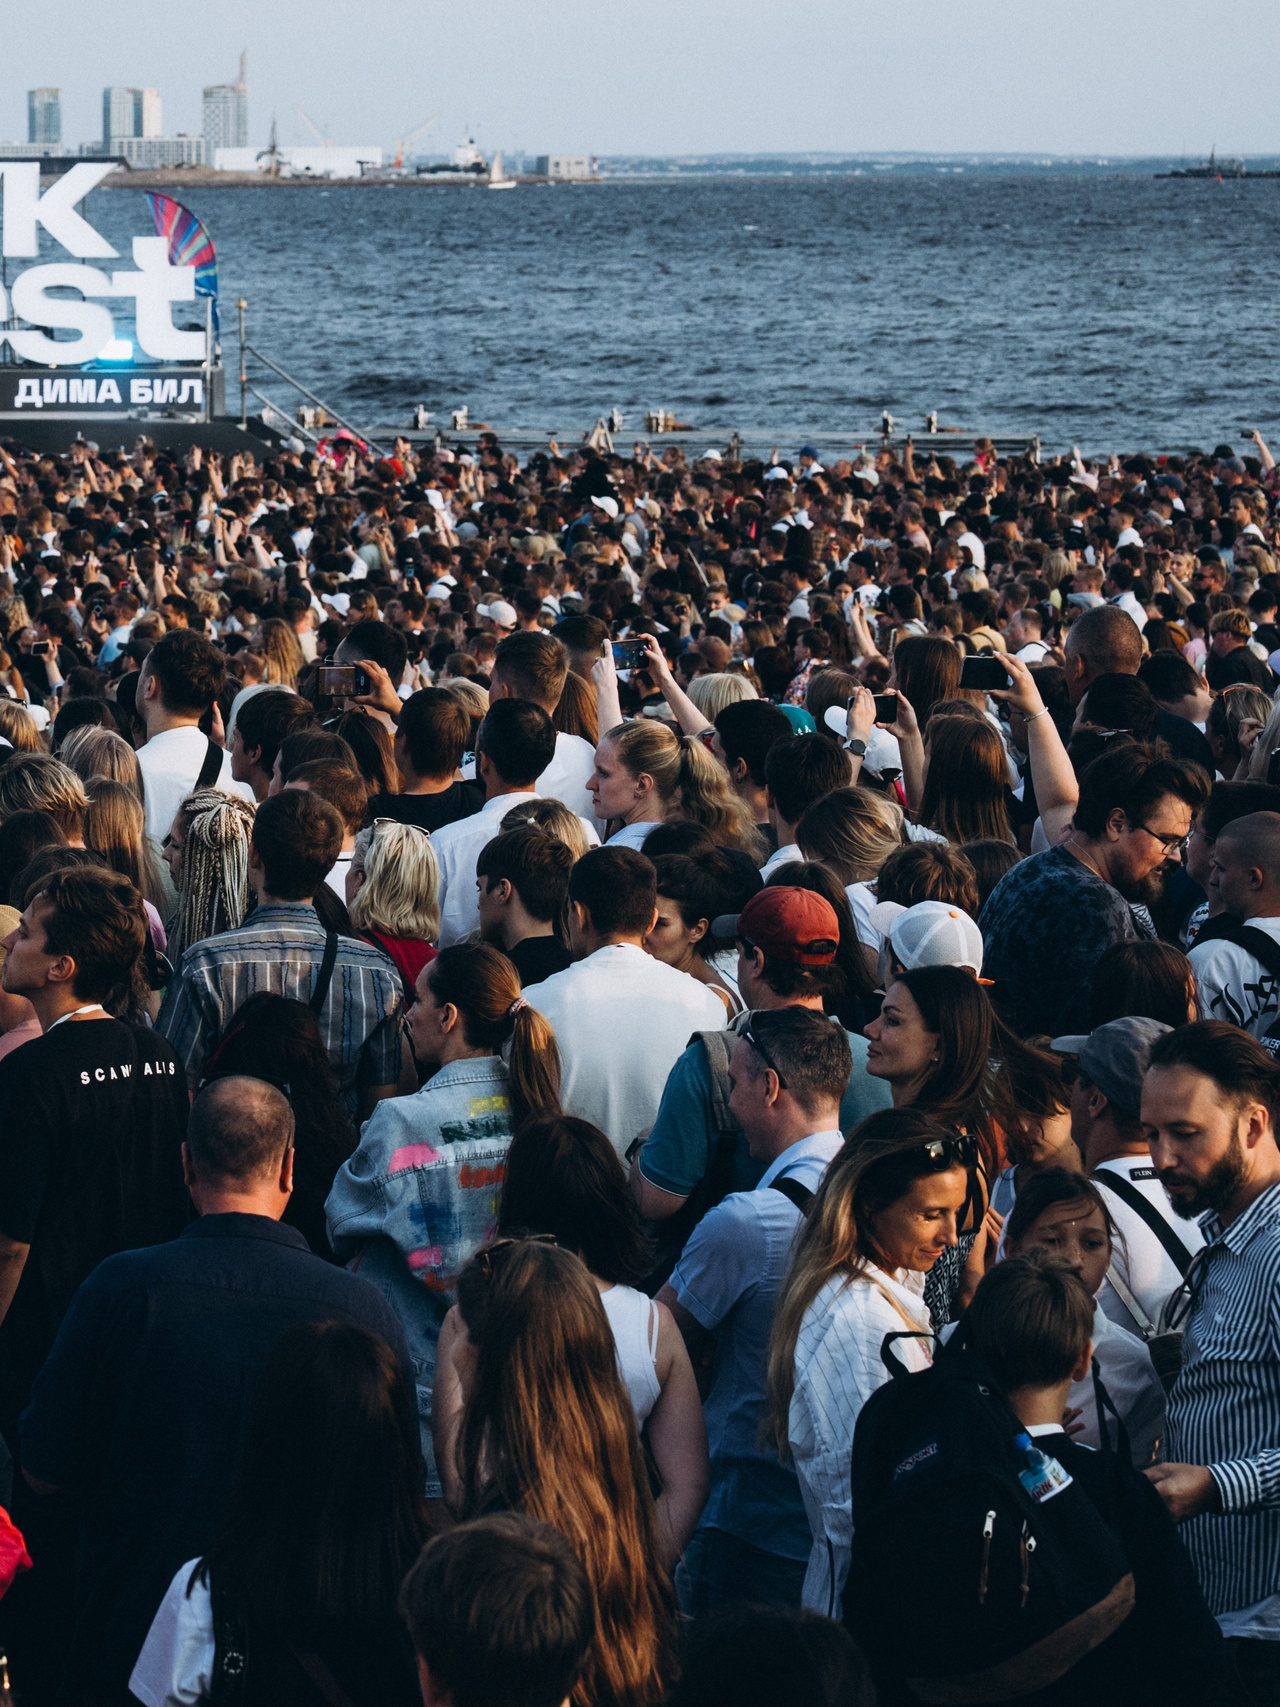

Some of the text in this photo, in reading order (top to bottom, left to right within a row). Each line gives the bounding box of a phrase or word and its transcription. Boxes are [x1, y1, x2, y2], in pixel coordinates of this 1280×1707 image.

[14, 378, 203, 408] ДИМА БИЛ
[80, 1061, 175, 1085] SCANALIS
